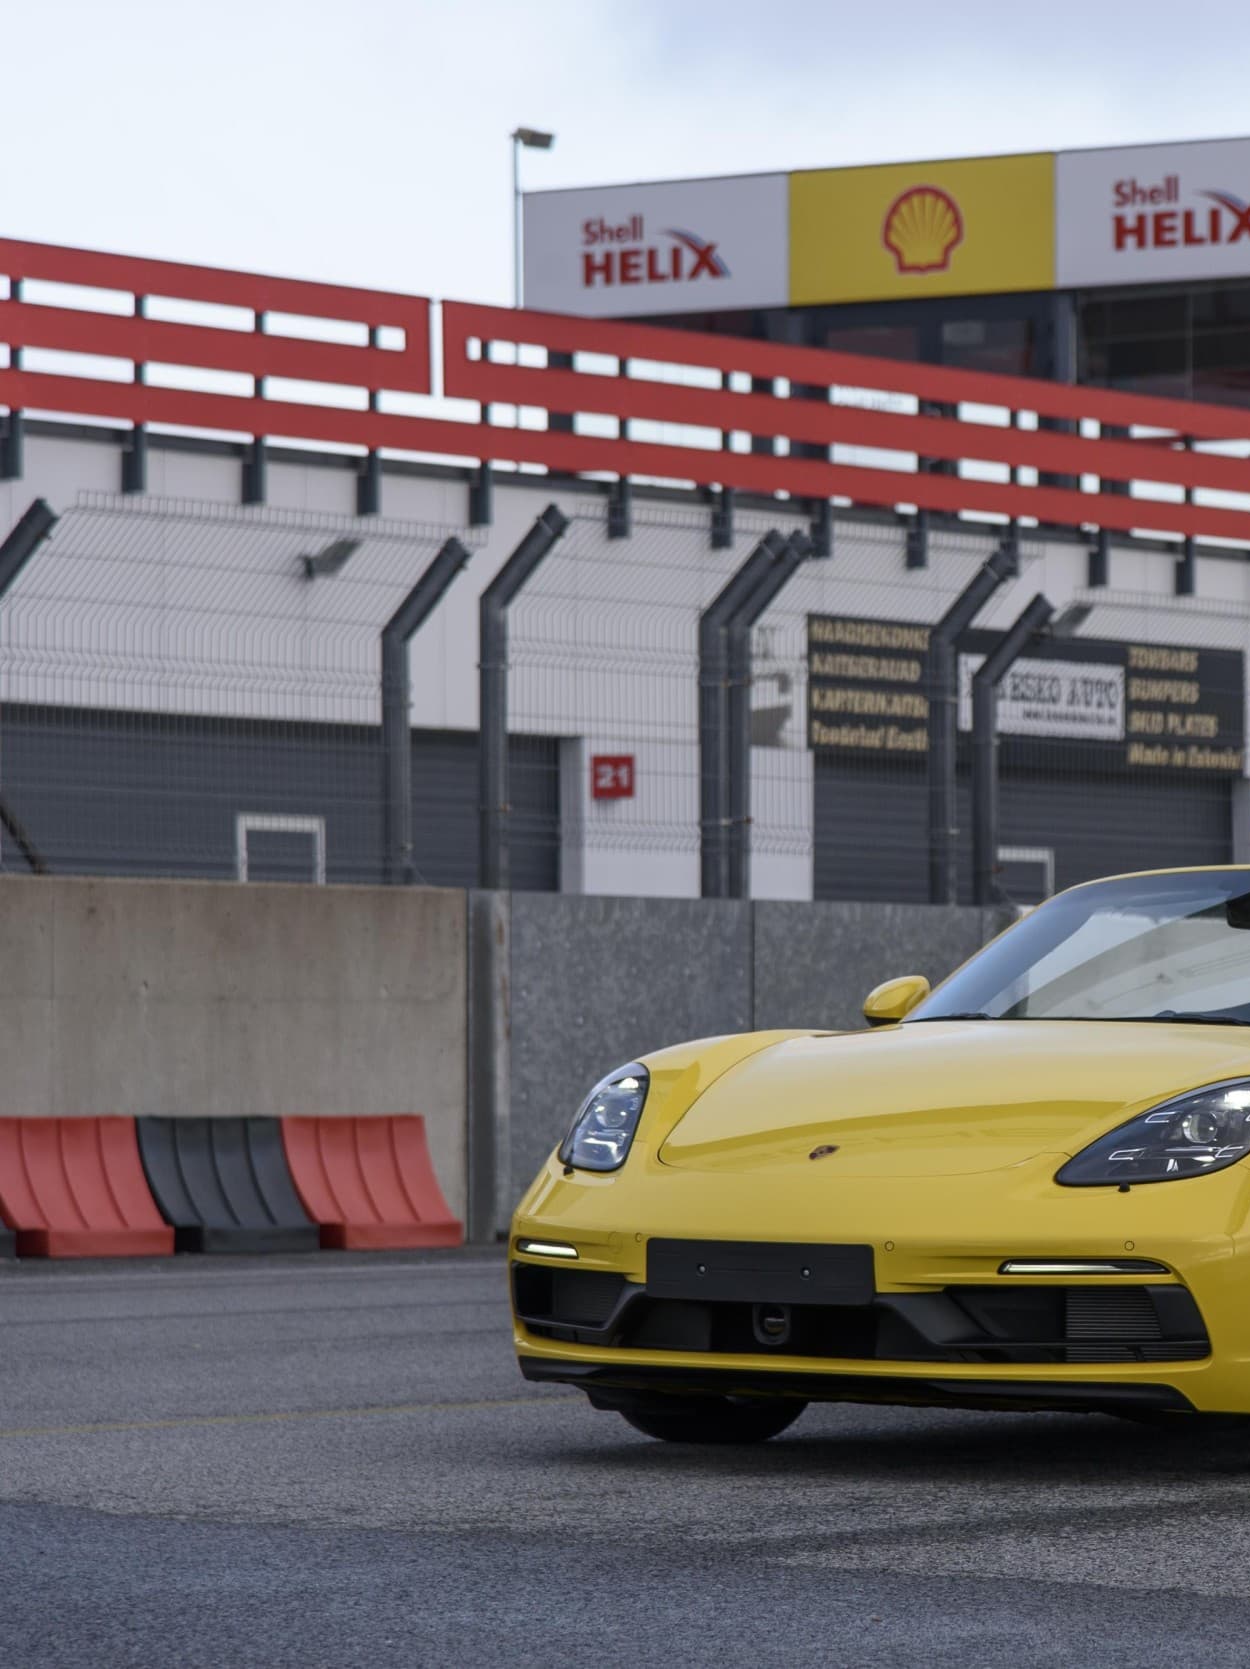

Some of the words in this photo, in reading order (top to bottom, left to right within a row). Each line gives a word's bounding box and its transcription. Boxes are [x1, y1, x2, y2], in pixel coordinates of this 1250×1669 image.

[1113, 174, 1180, 208] Shell
[582, 213, 644, 246] Shell
[583, 241, 725, 288] HELIX
[1129, 678, 1201, 704] BUMPERS
[1166, 713, 1219, 738] PLATES
[597, 764, 629, 789] 21
